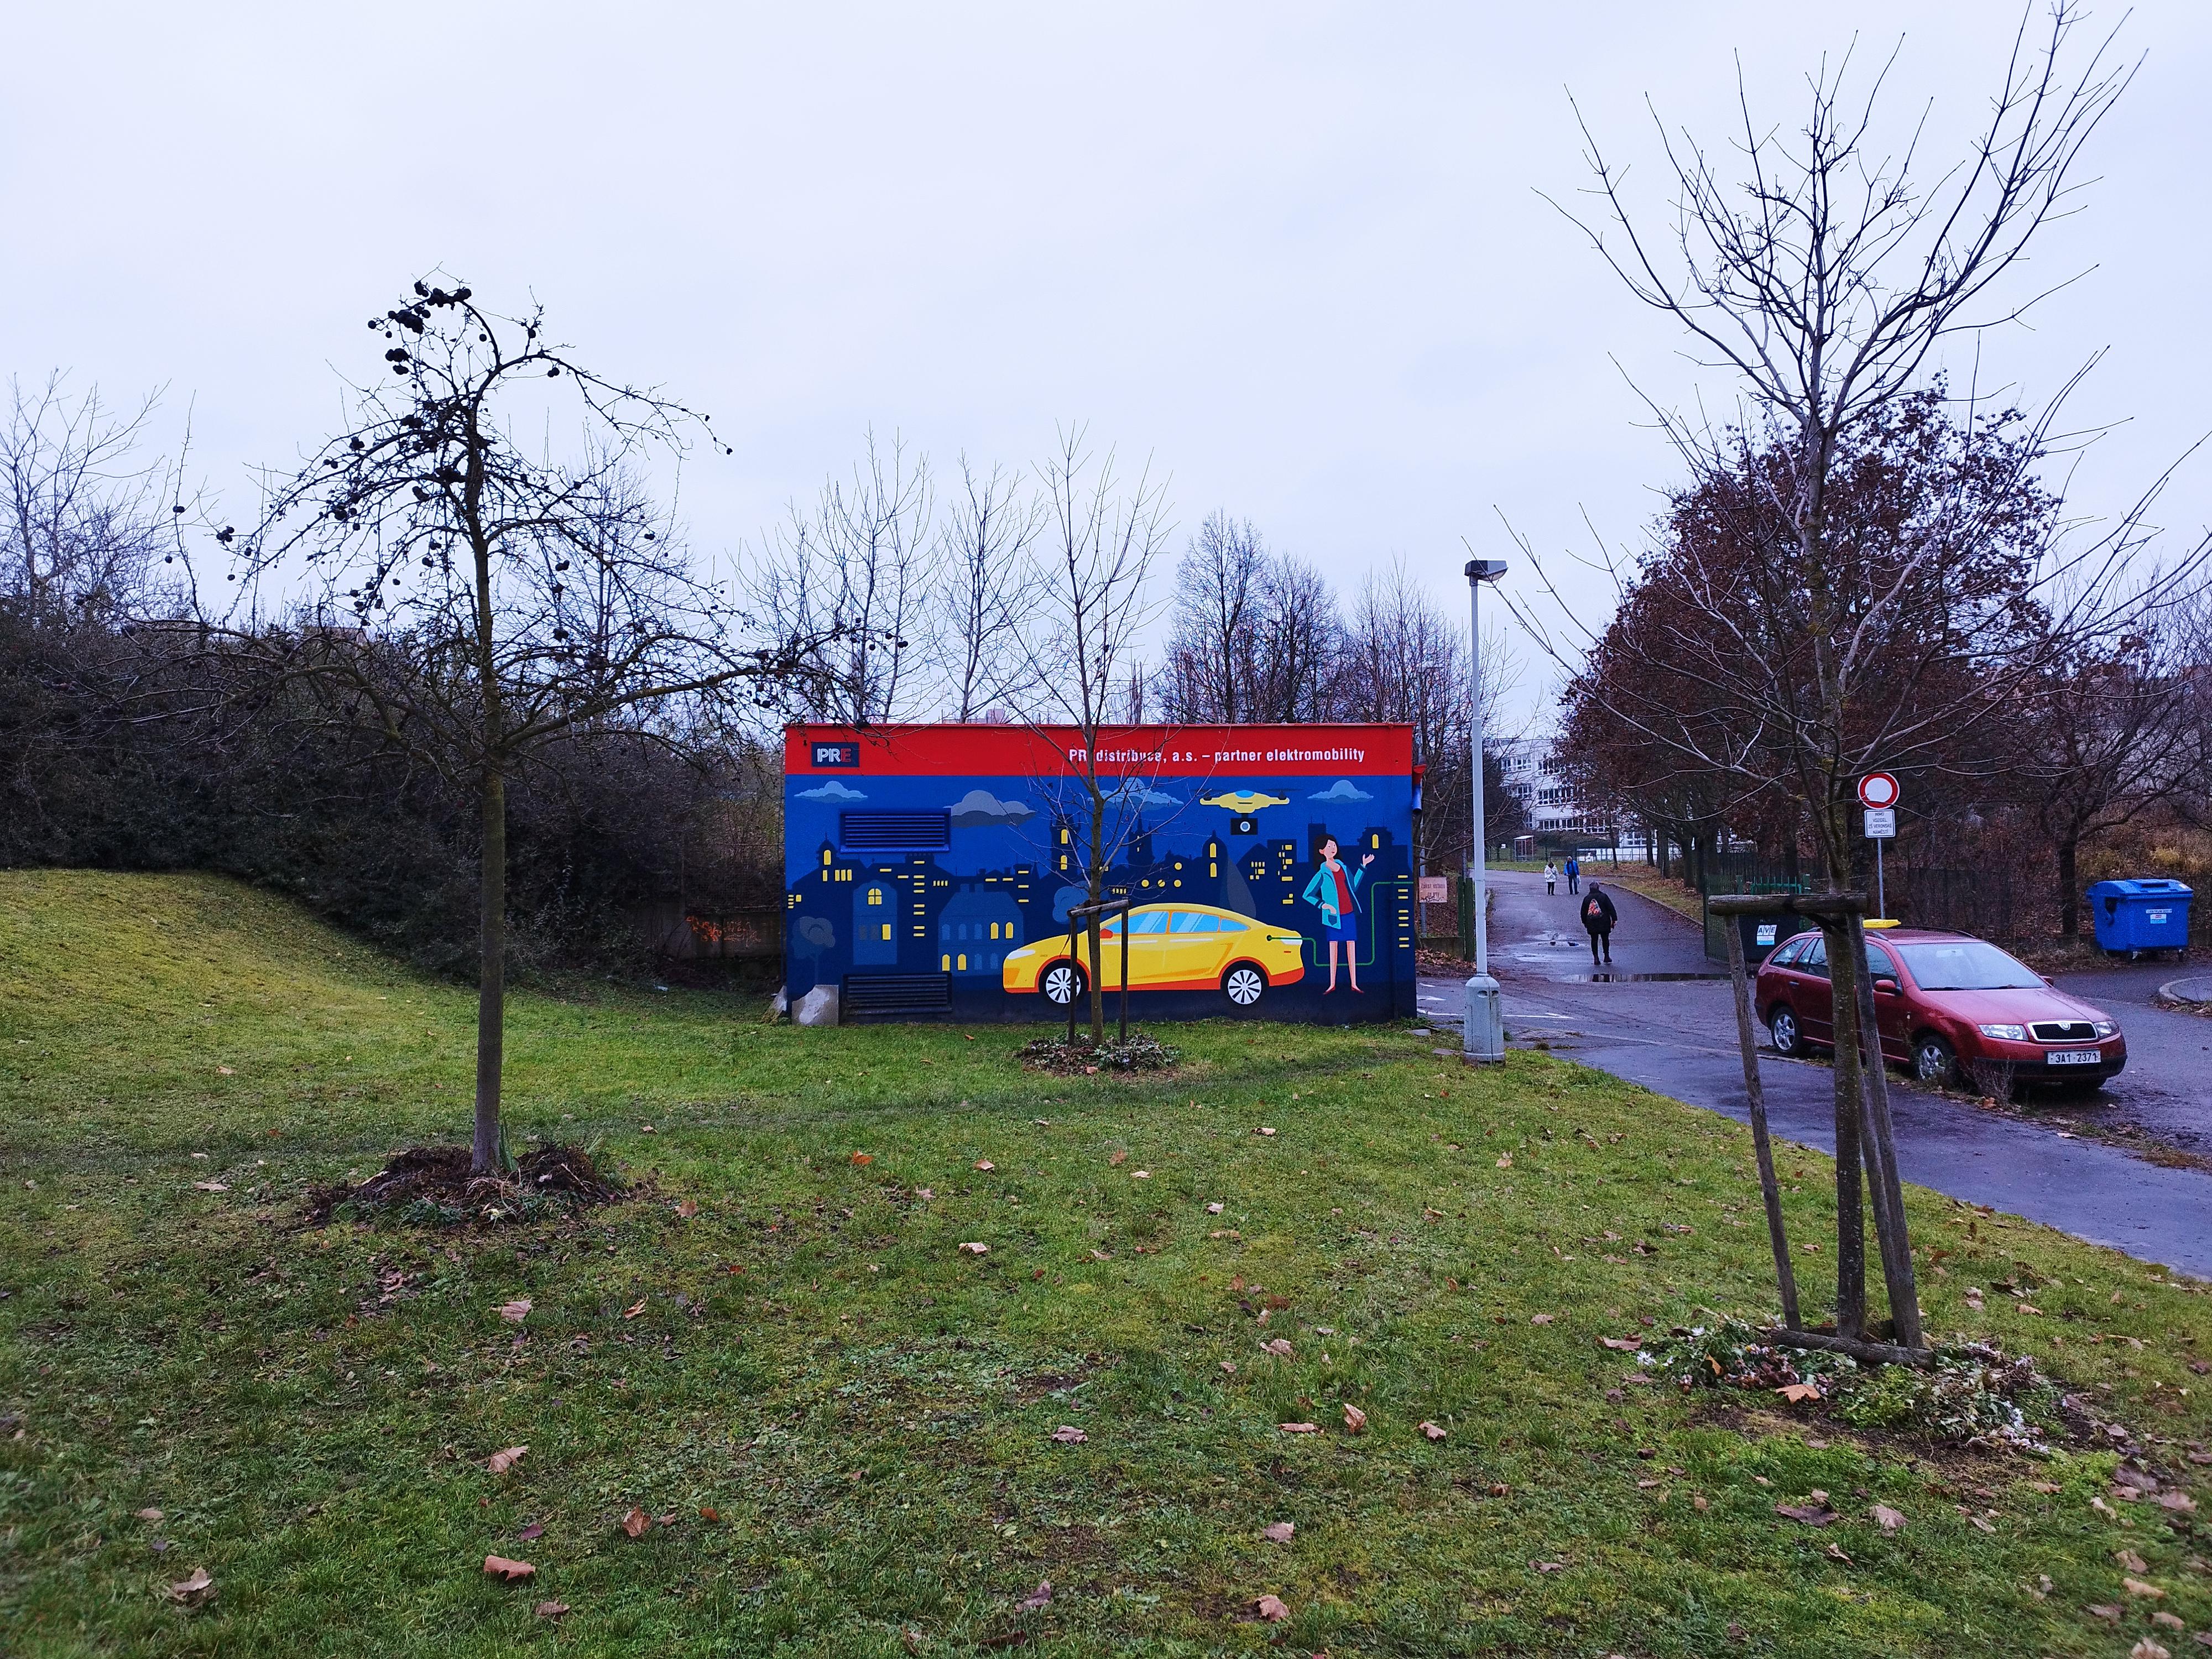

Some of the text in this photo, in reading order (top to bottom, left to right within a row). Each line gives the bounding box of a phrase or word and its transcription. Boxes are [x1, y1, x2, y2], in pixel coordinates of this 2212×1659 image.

[817, 748, 851, 762] PRE
[1069, 749, 1167, 763] PRdistribuce,
[1172, 752, 1197, 761] a.s.
[1215, 749, 1262, 764] partner
[1266, 748, 1364, 763] elektromobility
[2056, 1053, 2096, 1063] 3A1 2371
